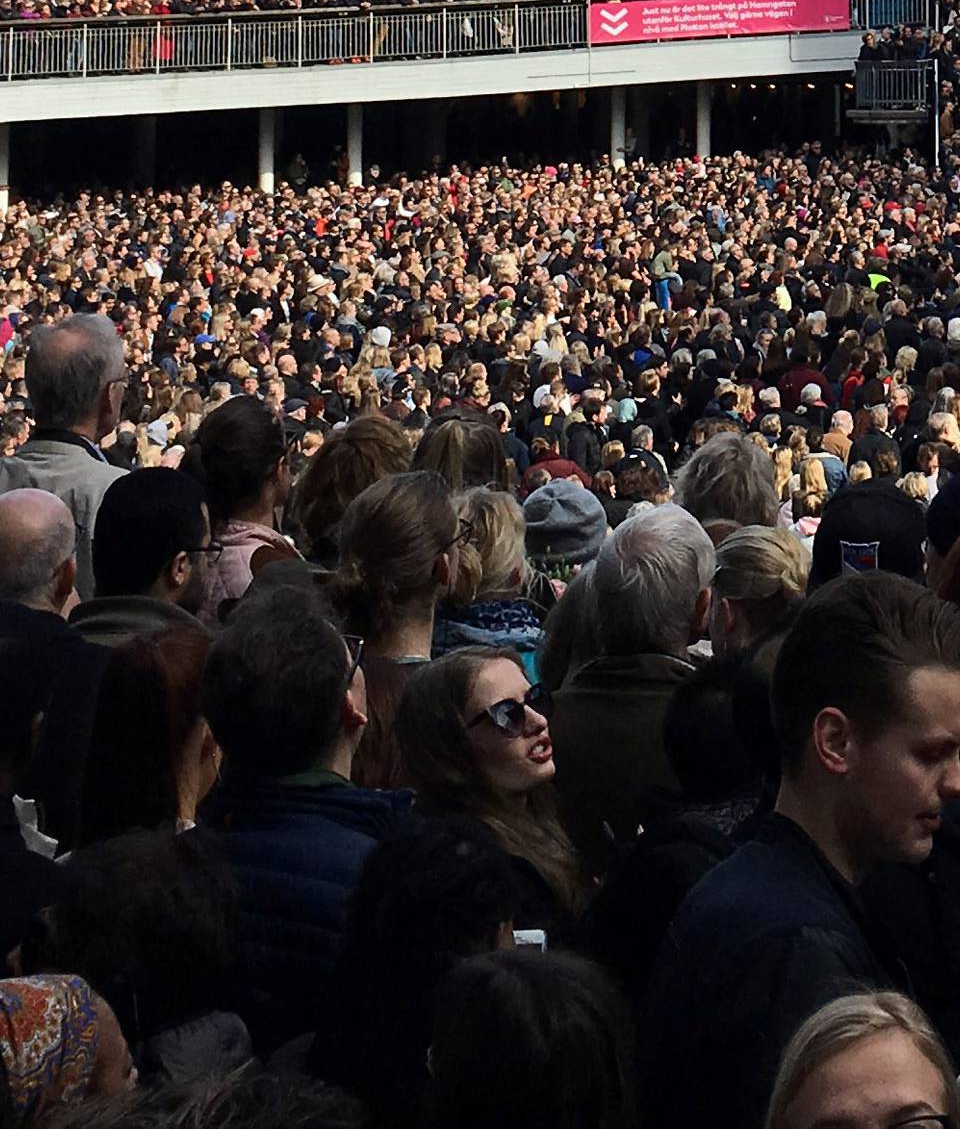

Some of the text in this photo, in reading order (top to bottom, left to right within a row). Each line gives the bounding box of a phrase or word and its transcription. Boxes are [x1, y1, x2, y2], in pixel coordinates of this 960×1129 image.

[642, 6, 659, 15] Just
[681, 4, 696, 13] det
[737, 1, 748, 10] på
